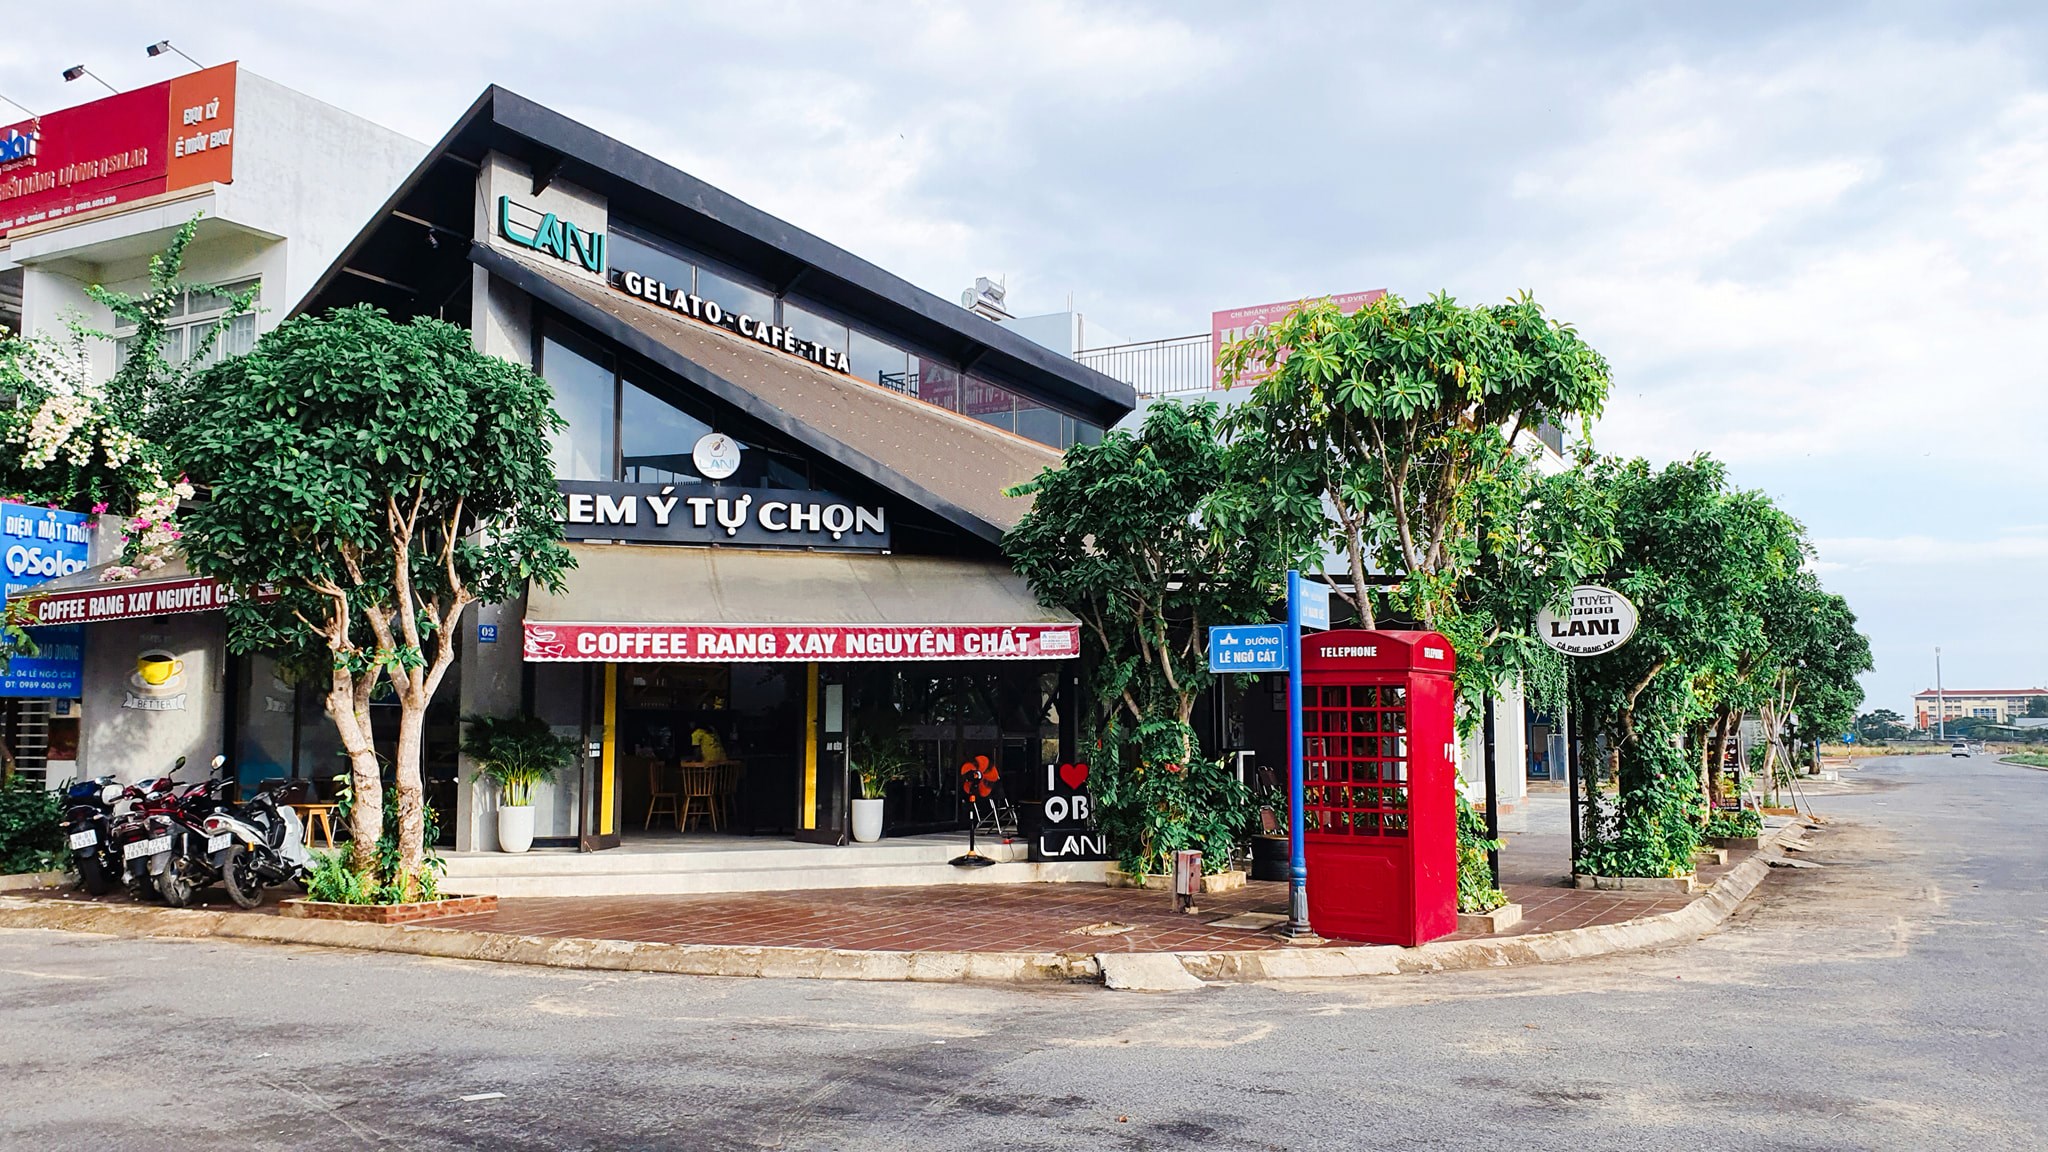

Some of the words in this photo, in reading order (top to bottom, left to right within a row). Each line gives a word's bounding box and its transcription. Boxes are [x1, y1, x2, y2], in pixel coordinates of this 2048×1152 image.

[206, 97, 220, 119] LÝ
[185, 132, 209, 155] MÁY
[210, 128, 232, 148] BAY
[23, 171, 55, 194] NĂNG
[58, 160, 98, 187] LƯỢNG
[100, 148, 148, 177] QSOLAR
[498, 195, 605, 273] LANI
[625, 271, 722, 324] GELATO
[739, 314, 795, 351] CAFÉ
[811, 341, 849, 373] TEA
[699, 459, 734, 469] LANI
[646, 486, 679, 525] Ý
[687, 494, 752, 536] TỰ
[758, 501, 885, 540] CHỌN
[6, 514, 33, 538] ĐIỆN
[6, 545, 87, 577] QSolar
[38, 598, 85, 621] COFFEE
[89, 594, 124, 615] RANG
[128, 592, 154, 613] XAY
[156, 583, 211, 609] NGUYÊN
[482, 626, 495, 637] 02
[577, 632, 687, 654] COFFEE
[697, 633, 777, 654] RANG
[786, 633, 839, 654] XAY
[846, 629, 955, 654] NGUYÊN
[964, 626, 1030, 653] CHẤT
[1551, 619, 1620, 637] LANI
[1245, 636, 1279, 646] ĐƯỜNG
[1320, 646, 1377, 657] TELEPHONE
[1219, 649, 1231, 663] LÊ
[1233, 649, 1254, 663] NGÔ
[1257, 648, 1276, 662] CÁT
[16, 670, 27, 678] 04
[137, 699, 171, 708] BETTER
[1048, 764, 1055, 791] I
[1045, 795, 1088, 823] QB
[1040, 835, 1106, 856] LANI
